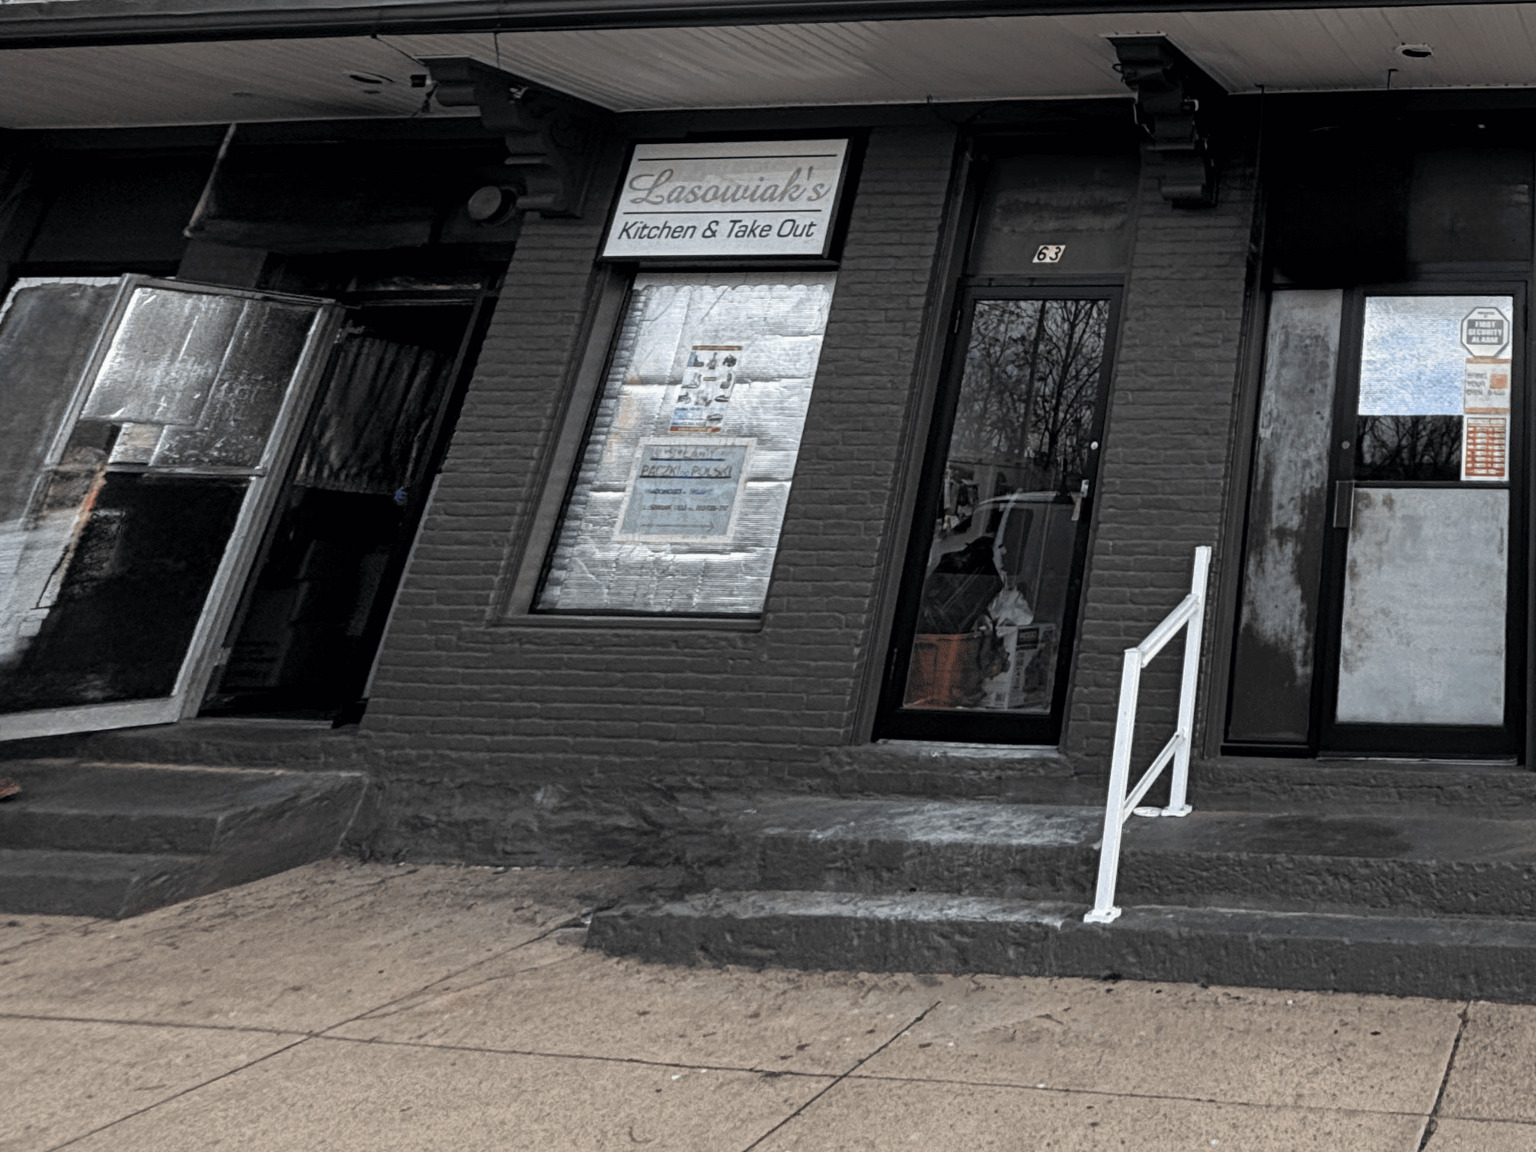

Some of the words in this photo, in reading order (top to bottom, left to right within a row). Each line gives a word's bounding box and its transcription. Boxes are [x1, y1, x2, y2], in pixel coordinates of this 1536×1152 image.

[628, 166, 832, 206] Lasowiak's
[617, 221, 697, 240] Kitchen
[701, 219, 719, 239] &
[727, 219, 773, 238] Take
[777, 218, 818, 238] Out
[1036, 246, 1062, 261] 63
